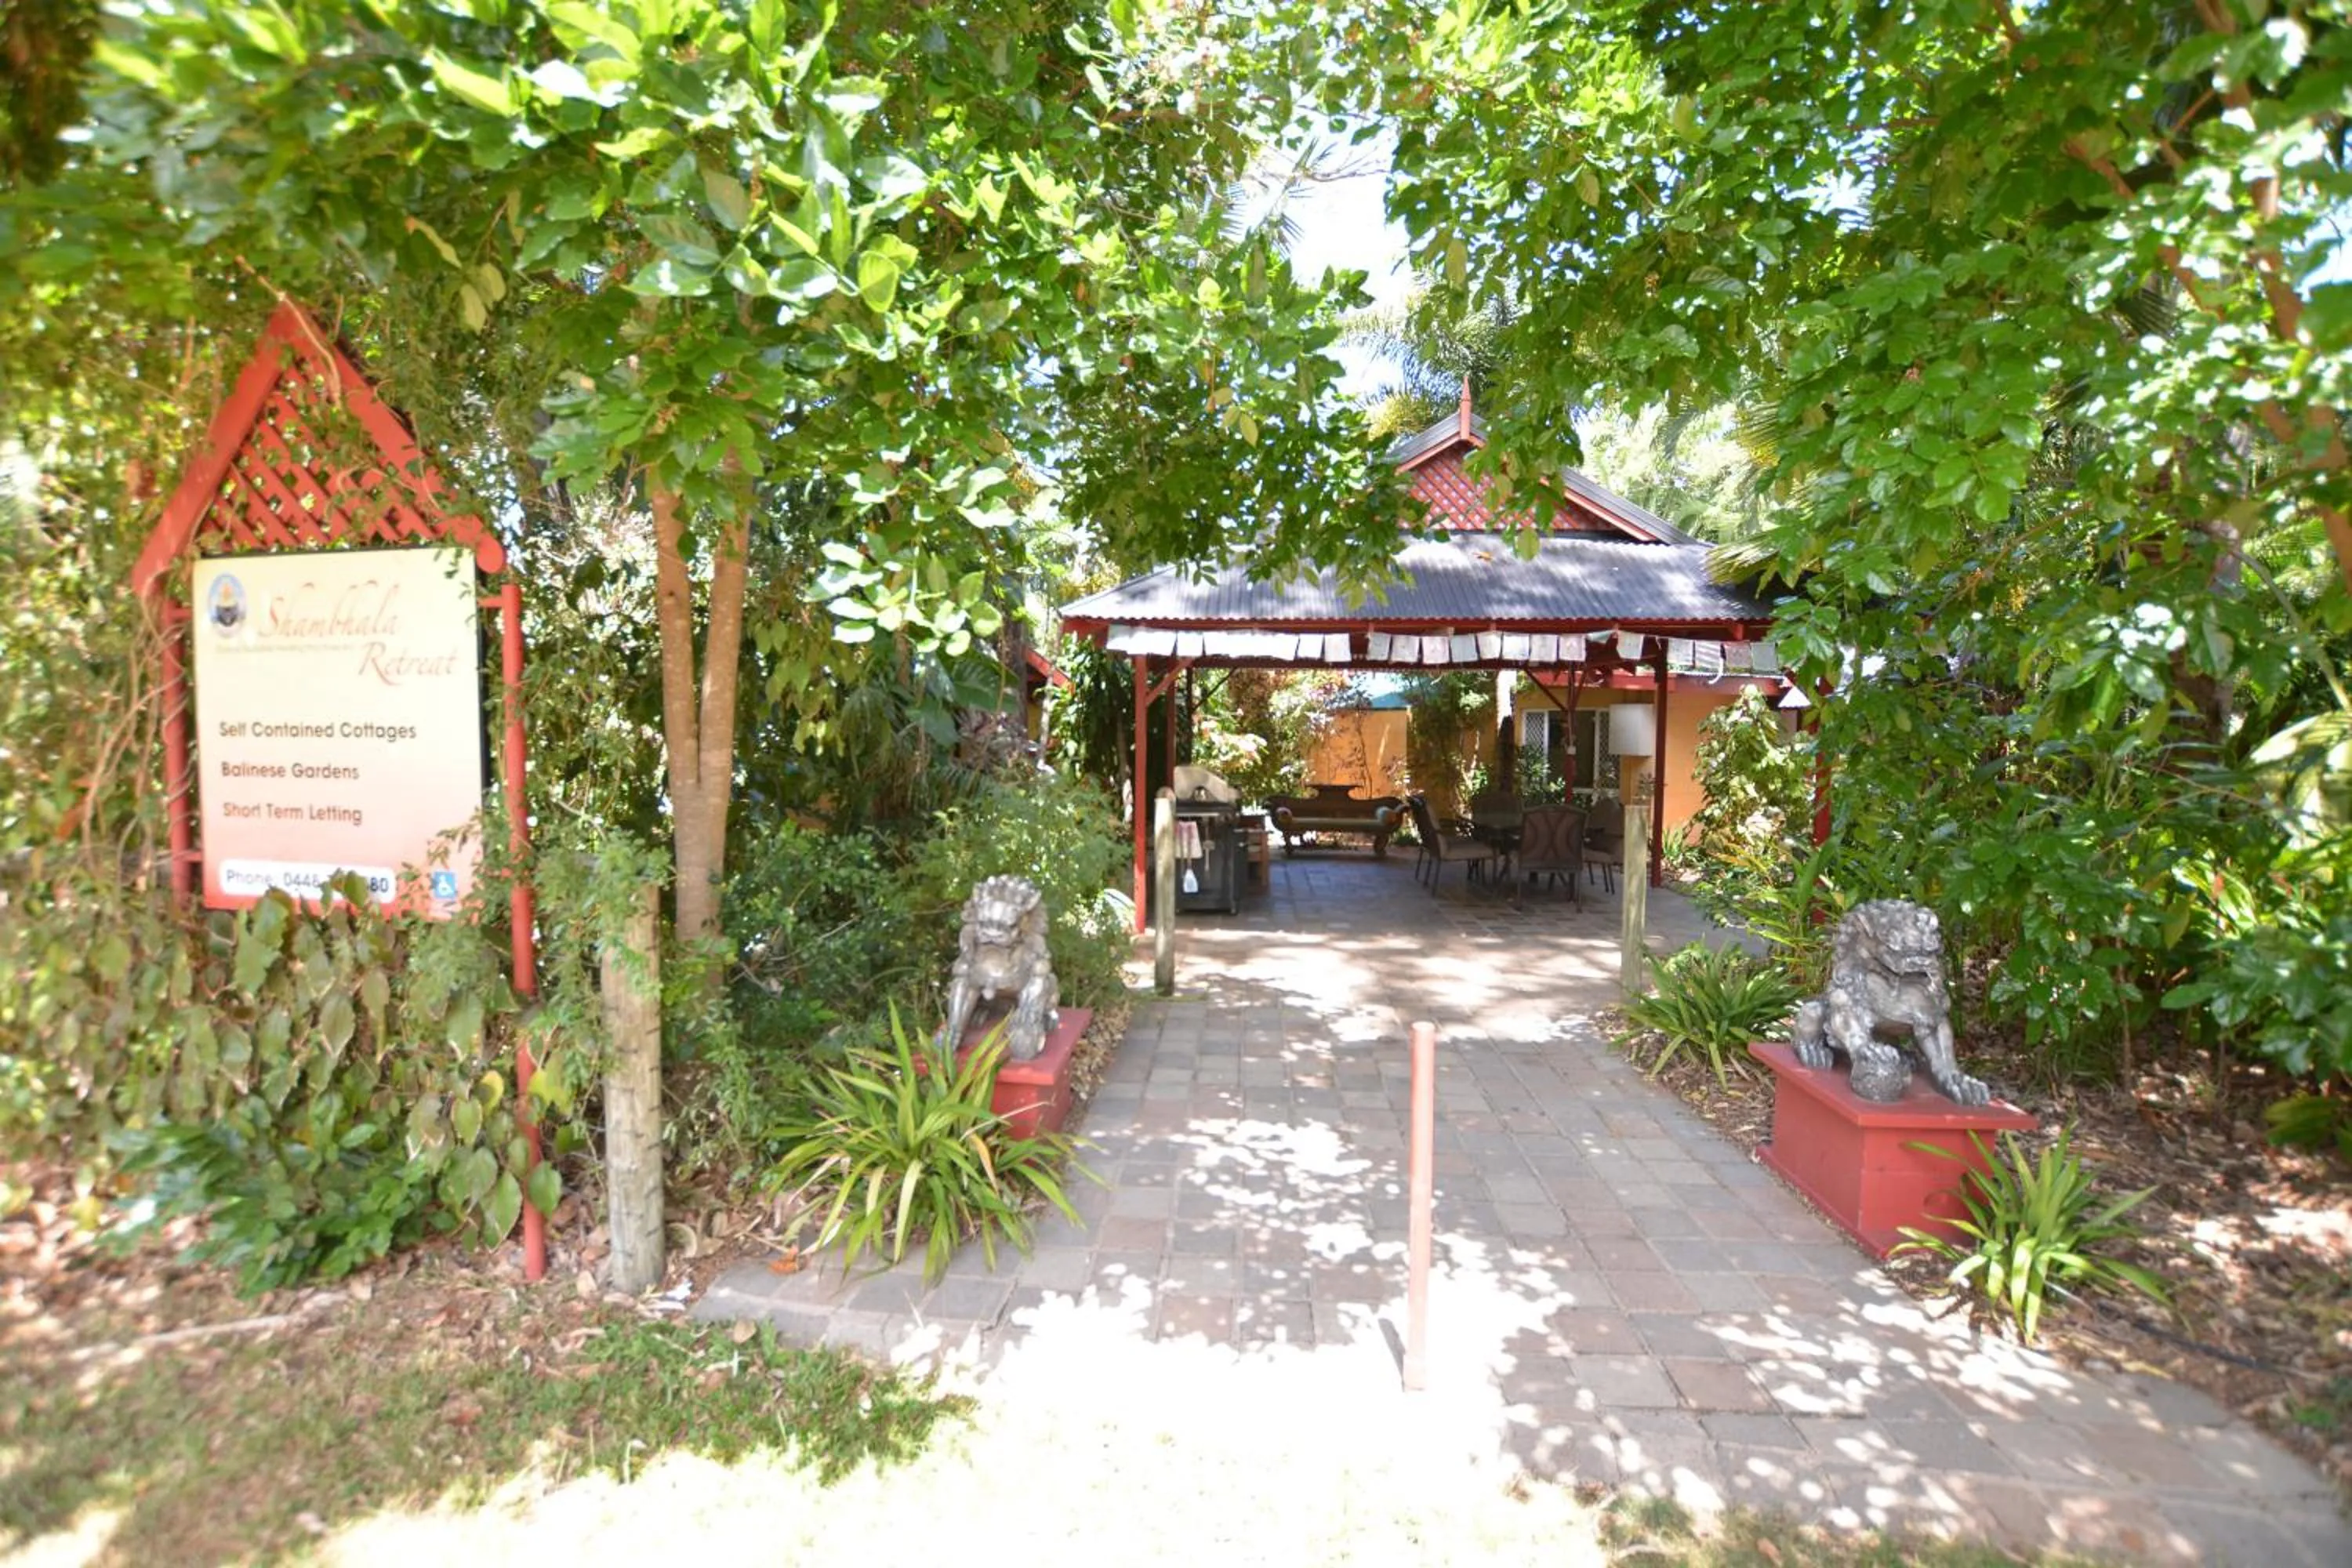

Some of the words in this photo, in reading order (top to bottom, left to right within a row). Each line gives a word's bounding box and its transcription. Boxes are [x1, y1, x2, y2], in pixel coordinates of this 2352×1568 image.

[358, 641, 458, 686] Retreat
[220, 722, 246, 738] Self
[252, 722, 335, 738] Contained
[340, 723, 416, 742] Cottages
[221, 761, 286, 778] Balinese
[292, 763, 359, 779] Gardens
[223, 803, 261, 817] Short
[266, 804, 303, 820] Term
[310, 805, 362, 826] Letting
